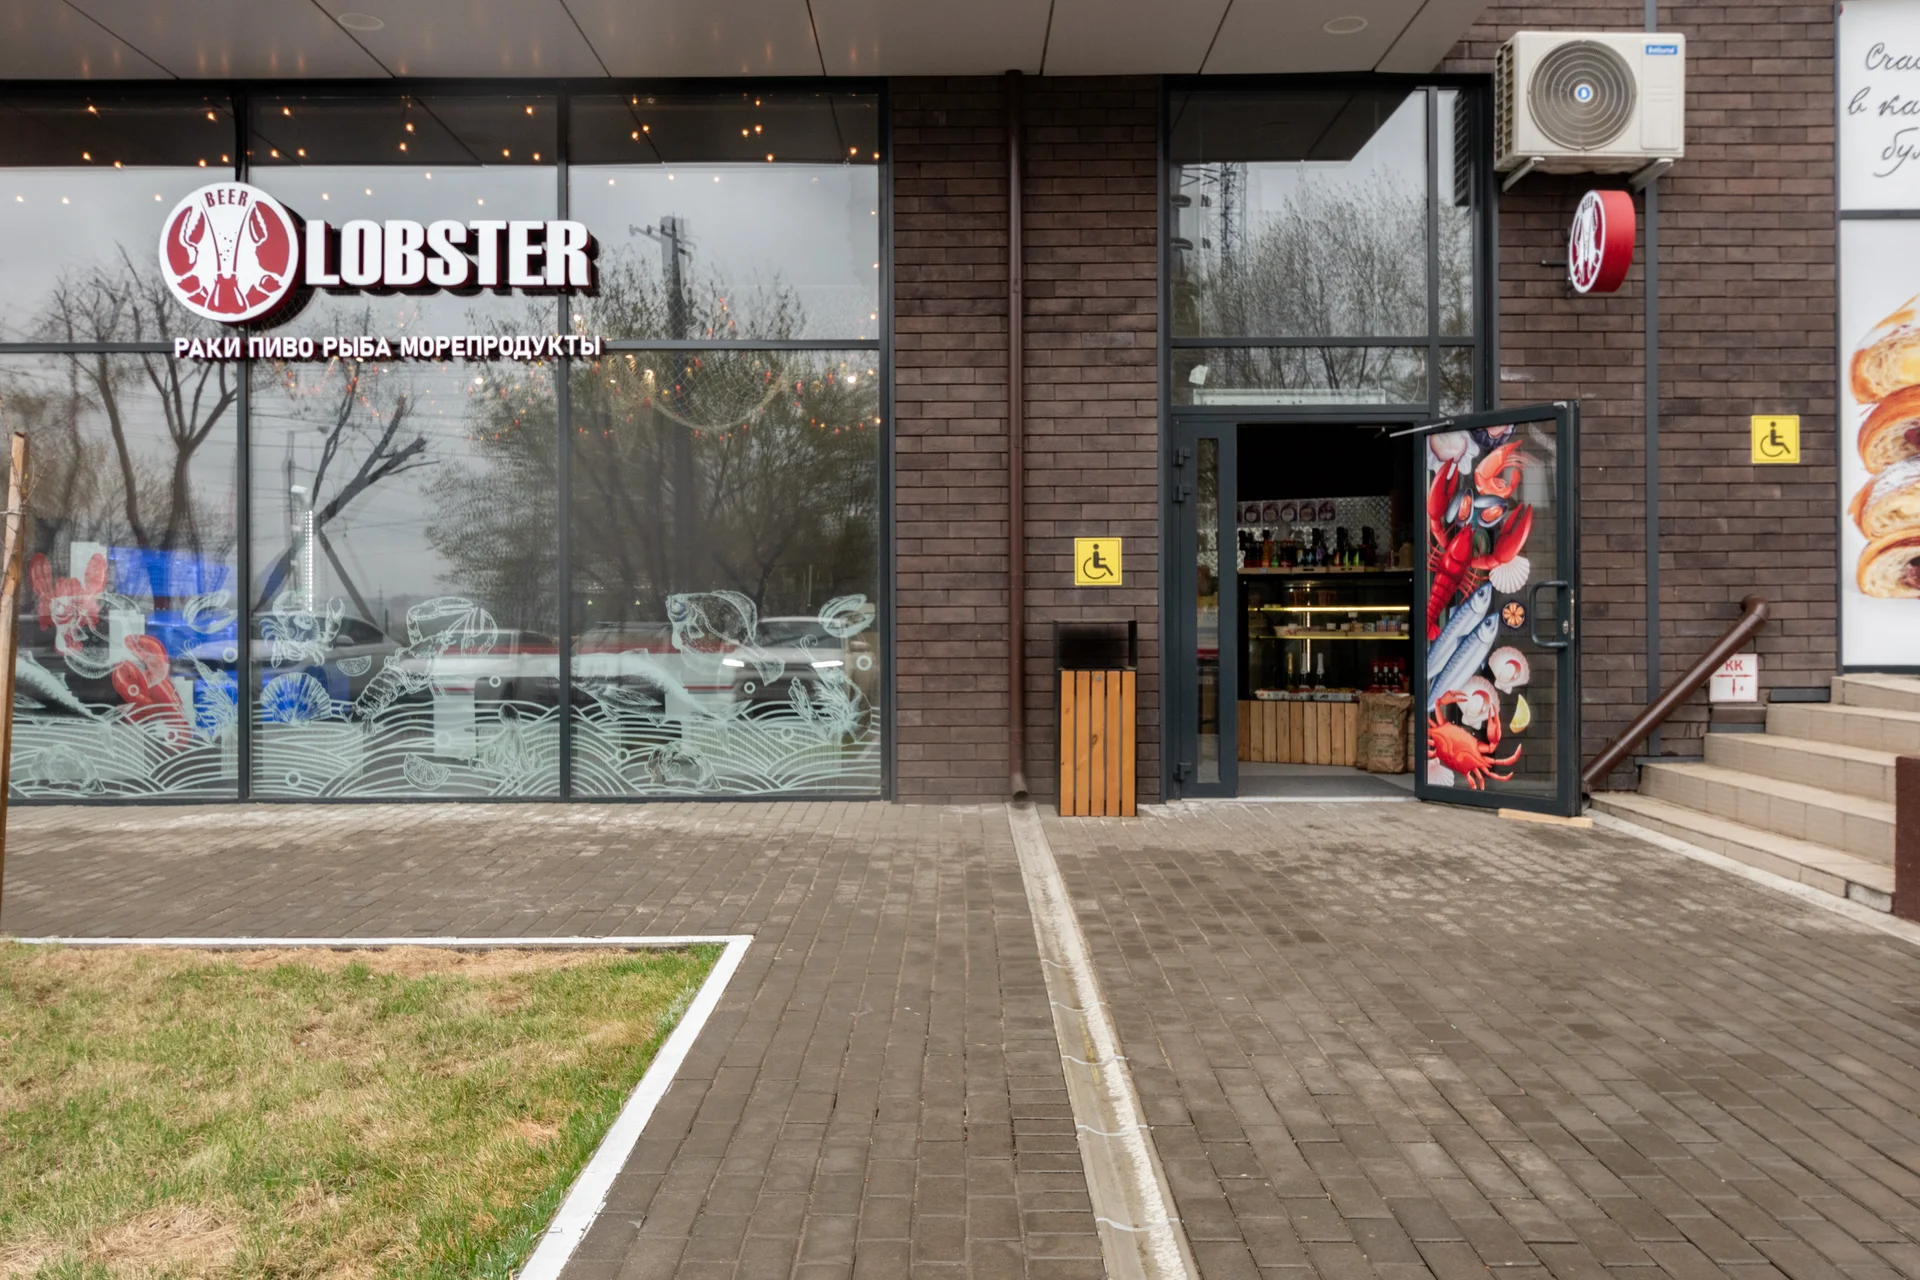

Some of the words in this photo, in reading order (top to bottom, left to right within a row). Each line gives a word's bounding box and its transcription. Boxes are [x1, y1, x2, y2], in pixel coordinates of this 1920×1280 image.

[204, 189, 249, 208] BEER
[305, 219, 591, 286] LOBSTER
[174, 337, 241, 358] РАКИ
[249, 337, 314, 358] ПИВО
[322, 336, 392, 358] РЫБА
[400, 335, 600, 360] МОРЕПРОДУКТЫ
